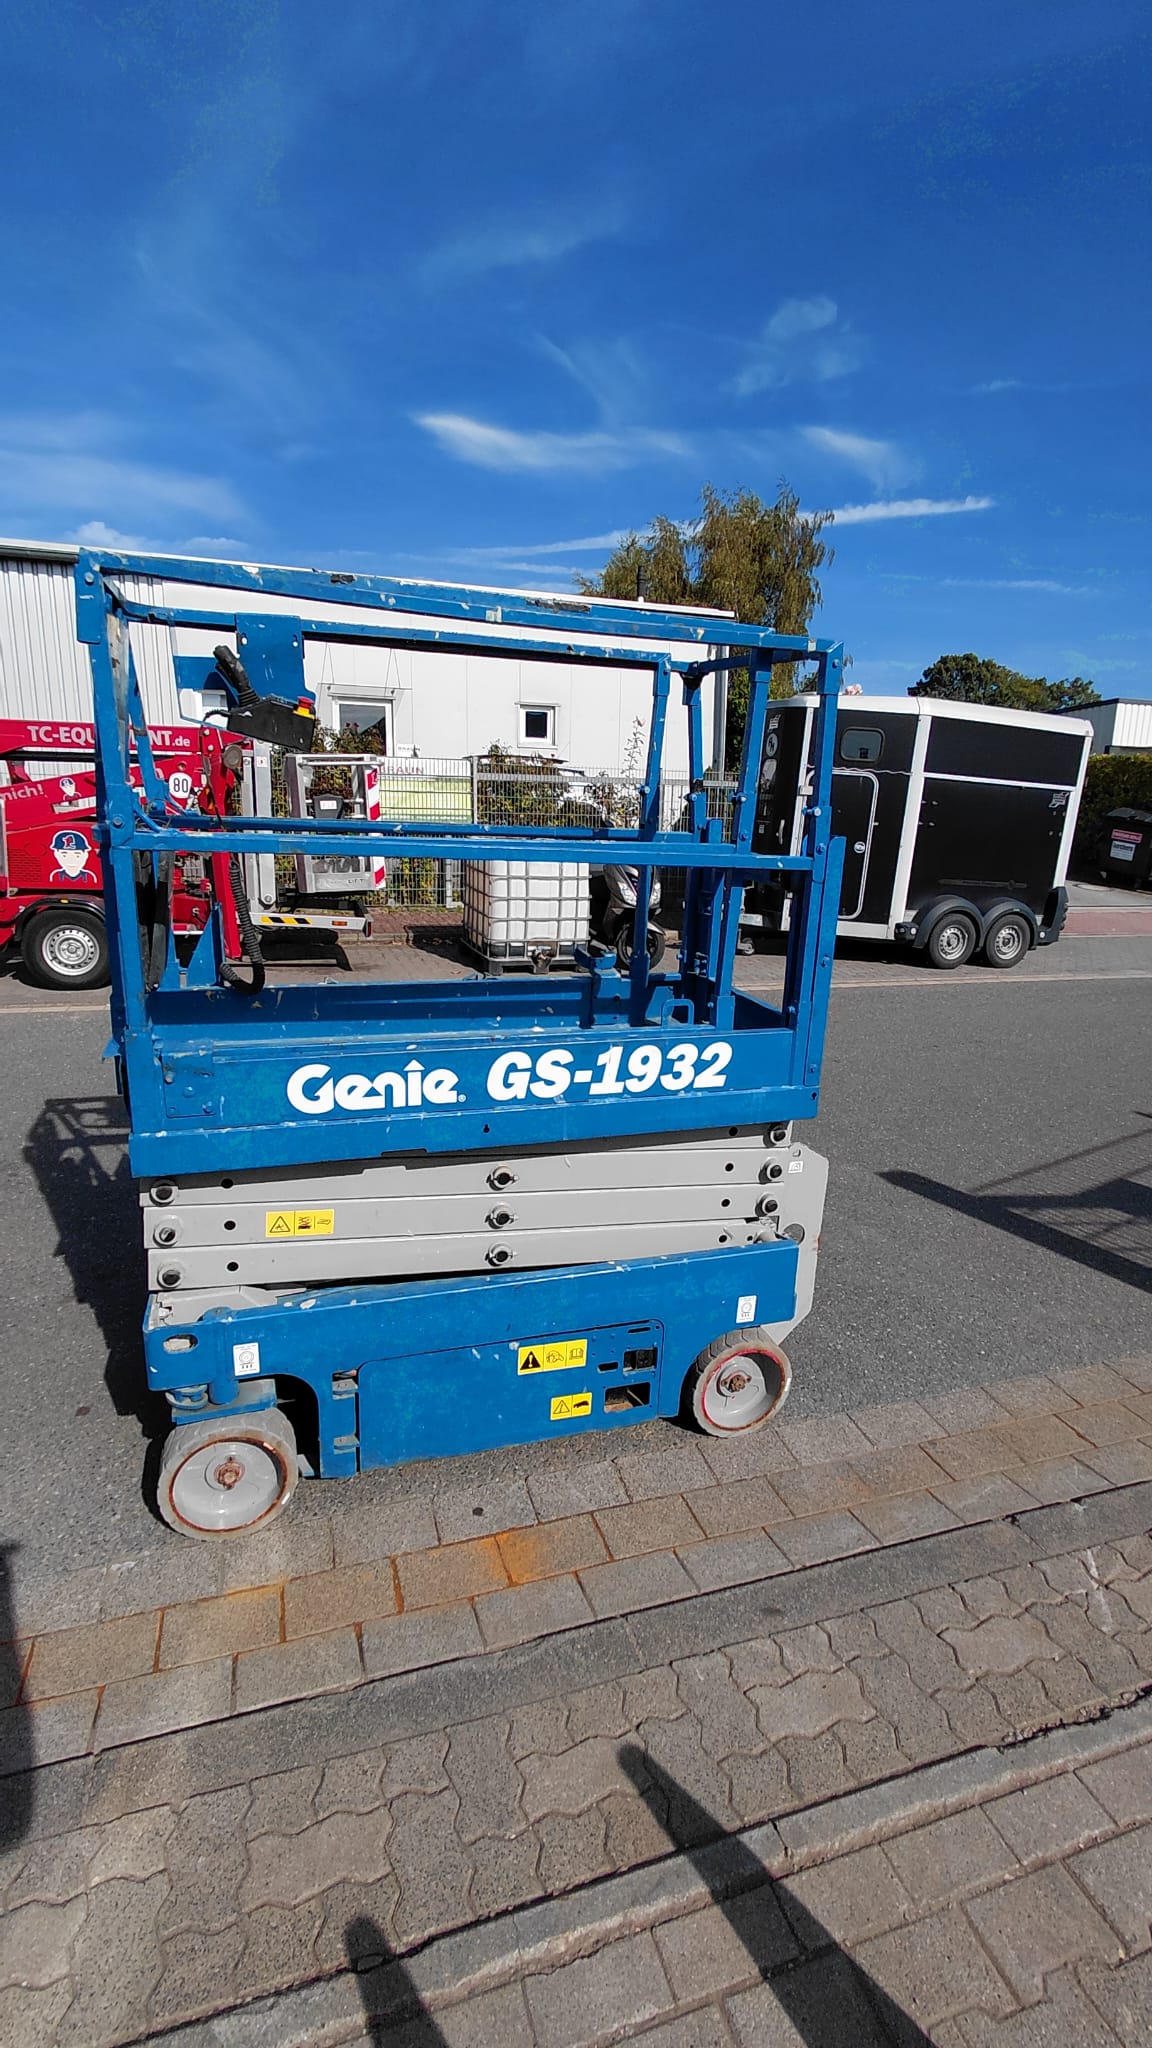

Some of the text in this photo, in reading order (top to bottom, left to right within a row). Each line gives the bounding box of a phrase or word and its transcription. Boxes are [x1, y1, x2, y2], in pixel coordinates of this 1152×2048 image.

[173, 777, 188, 793] 80
[286, 1041, 733, 1115] Genie GS-1932
